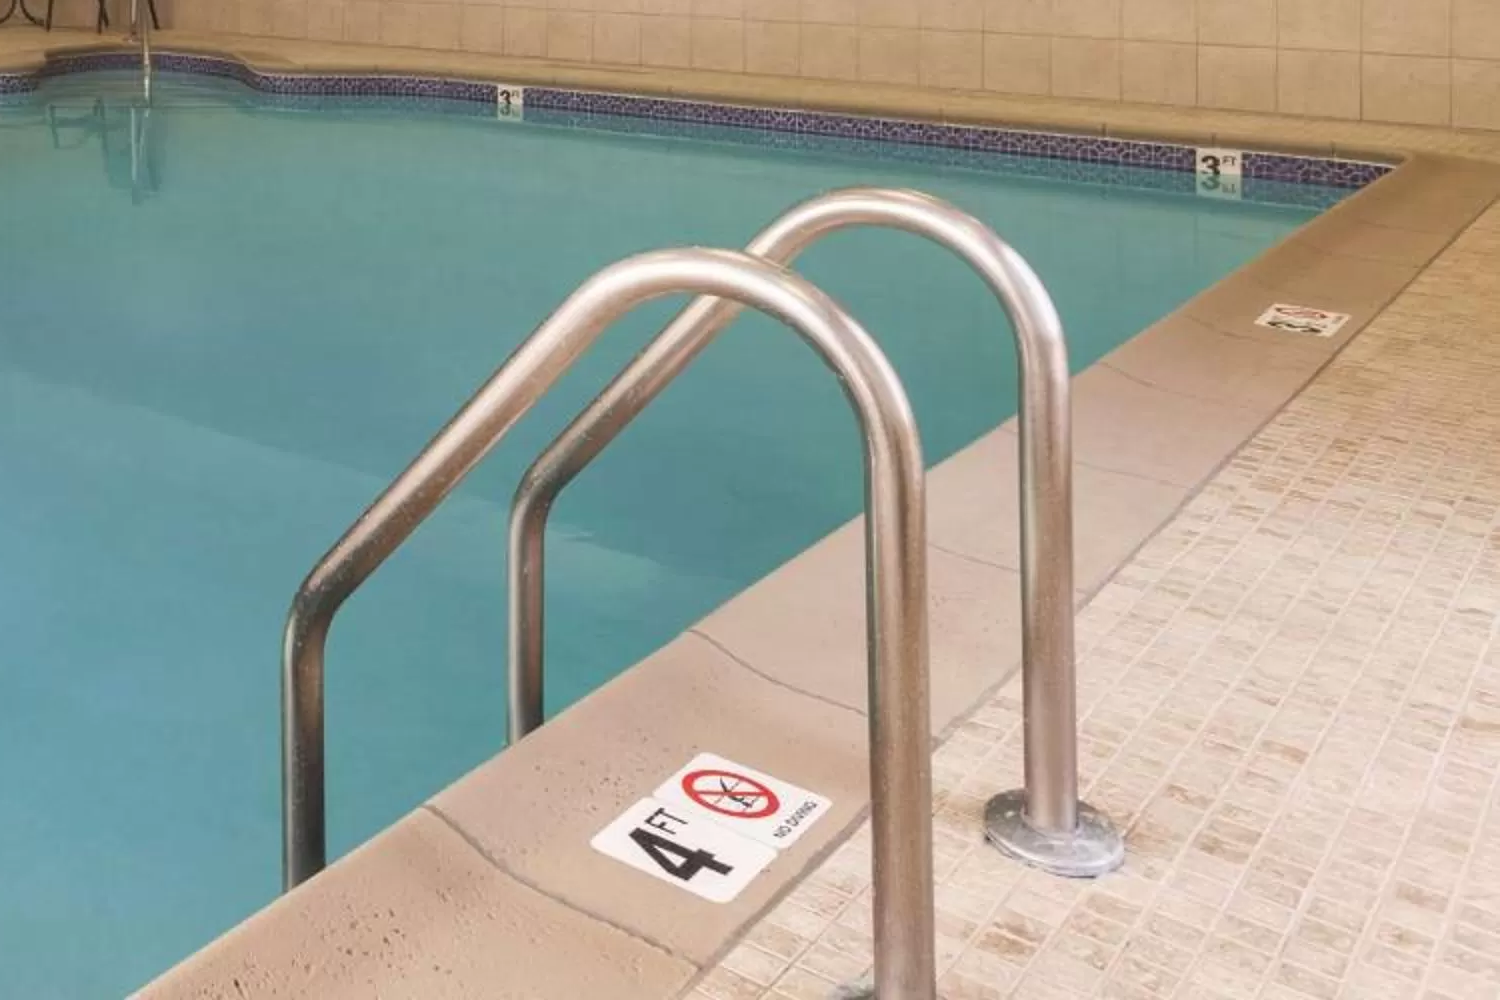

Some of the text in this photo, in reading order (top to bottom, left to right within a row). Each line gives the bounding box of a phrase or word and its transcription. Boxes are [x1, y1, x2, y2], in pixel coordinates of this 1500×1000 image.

[1201, 155, 1221, 176] 3
[628, 807, 735, 881] 4 FT
